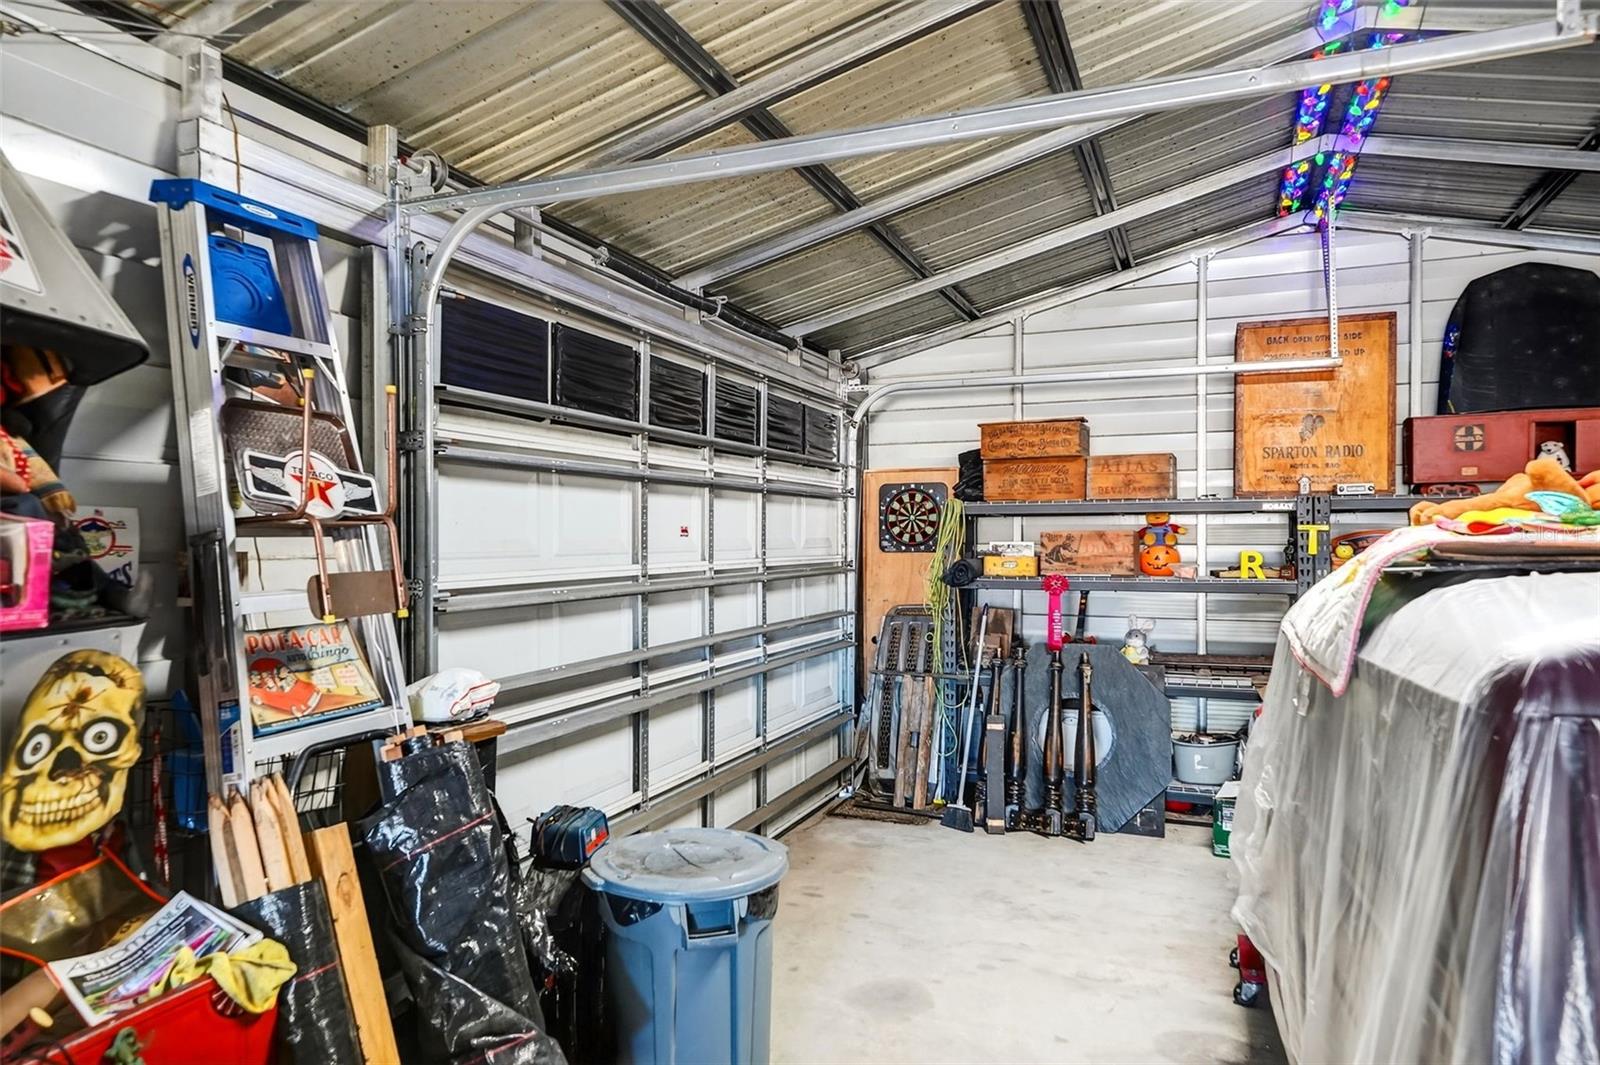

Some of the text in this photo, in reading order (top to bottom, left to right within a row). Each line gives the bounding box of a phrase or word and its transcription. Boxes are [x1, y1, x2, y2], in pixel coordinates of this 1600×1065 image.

[186, 273, 198, 331] WERNER
[1266, 335, 1289, 345] BACK
[1262, 444, 1364, 460] SPARTON RADIO
[291, 466, 334, 481] TEACO
[1297, 524, 1330, 556] T
[1239, 550, 1266, 580] R
